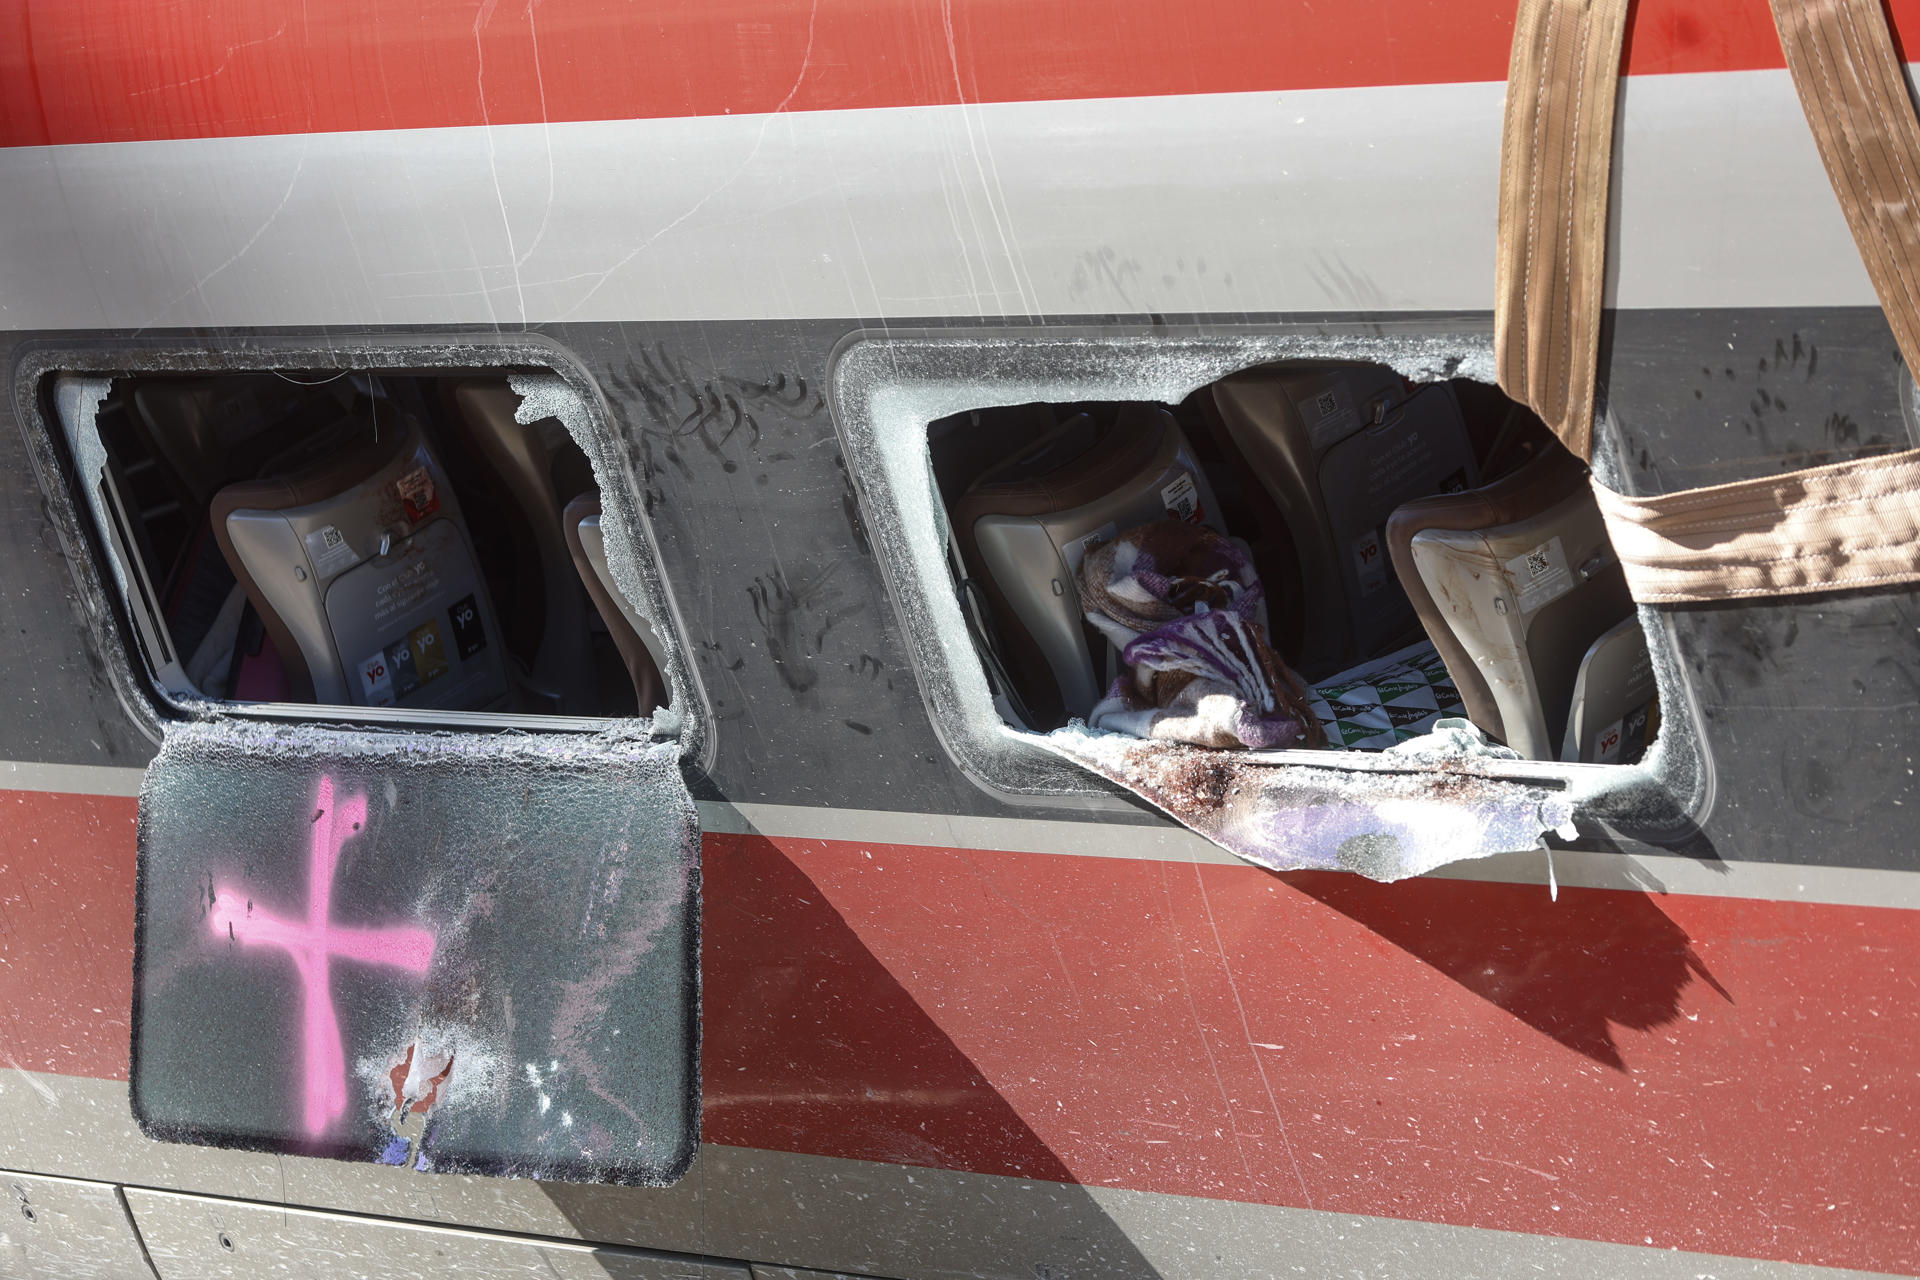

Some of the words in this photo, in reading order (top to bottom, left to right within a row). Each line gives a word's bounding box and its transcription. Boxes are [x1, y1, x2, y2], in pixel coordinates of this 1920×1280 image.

[1360, 544, 1377, 564] yo
[456, 608, 474, 630] yo
[416, 633, 435, 655] yo
[392, 649, 411, 670] yo
[366, 665, 385, 684] yo
[1628, 714, 1646, 736] yo
[1601, 733, 1618, 754] yo
